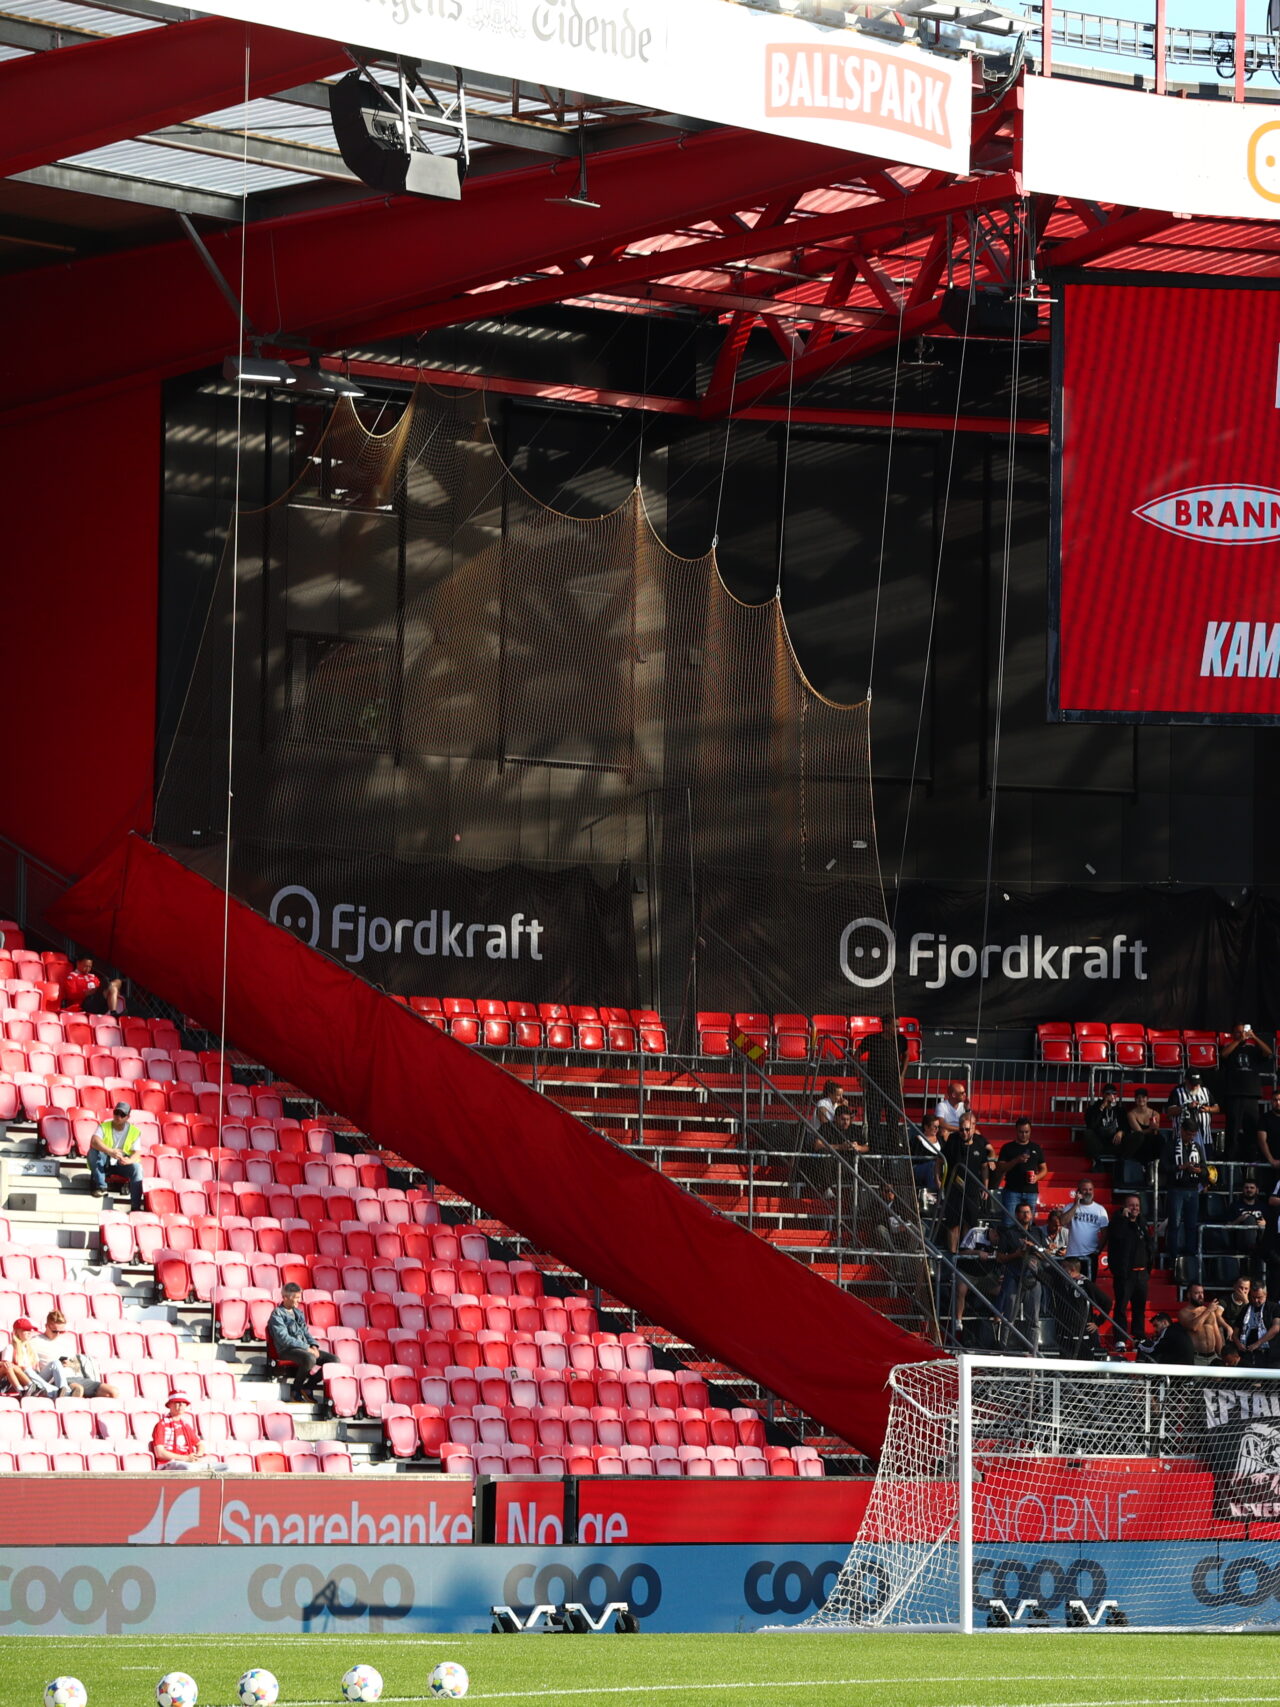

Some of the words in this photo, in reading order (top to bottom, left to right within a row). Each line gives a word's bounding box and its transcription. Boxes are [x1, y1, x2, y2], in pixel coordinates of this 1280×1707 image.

[532, 0, 652, 63] Tidende
[331, 903, 544, 963] Fjordkraft
[909, 933, 1148, 989] Fjordkraft
[508, 1501, 627, 1544] Noge
[248, 1563, 415, 1633] coop
[502, 1562, 662, 1618] coop
[744, 1560, 888, 1624] coop
[970, 1558, 1107, 1612] coop
